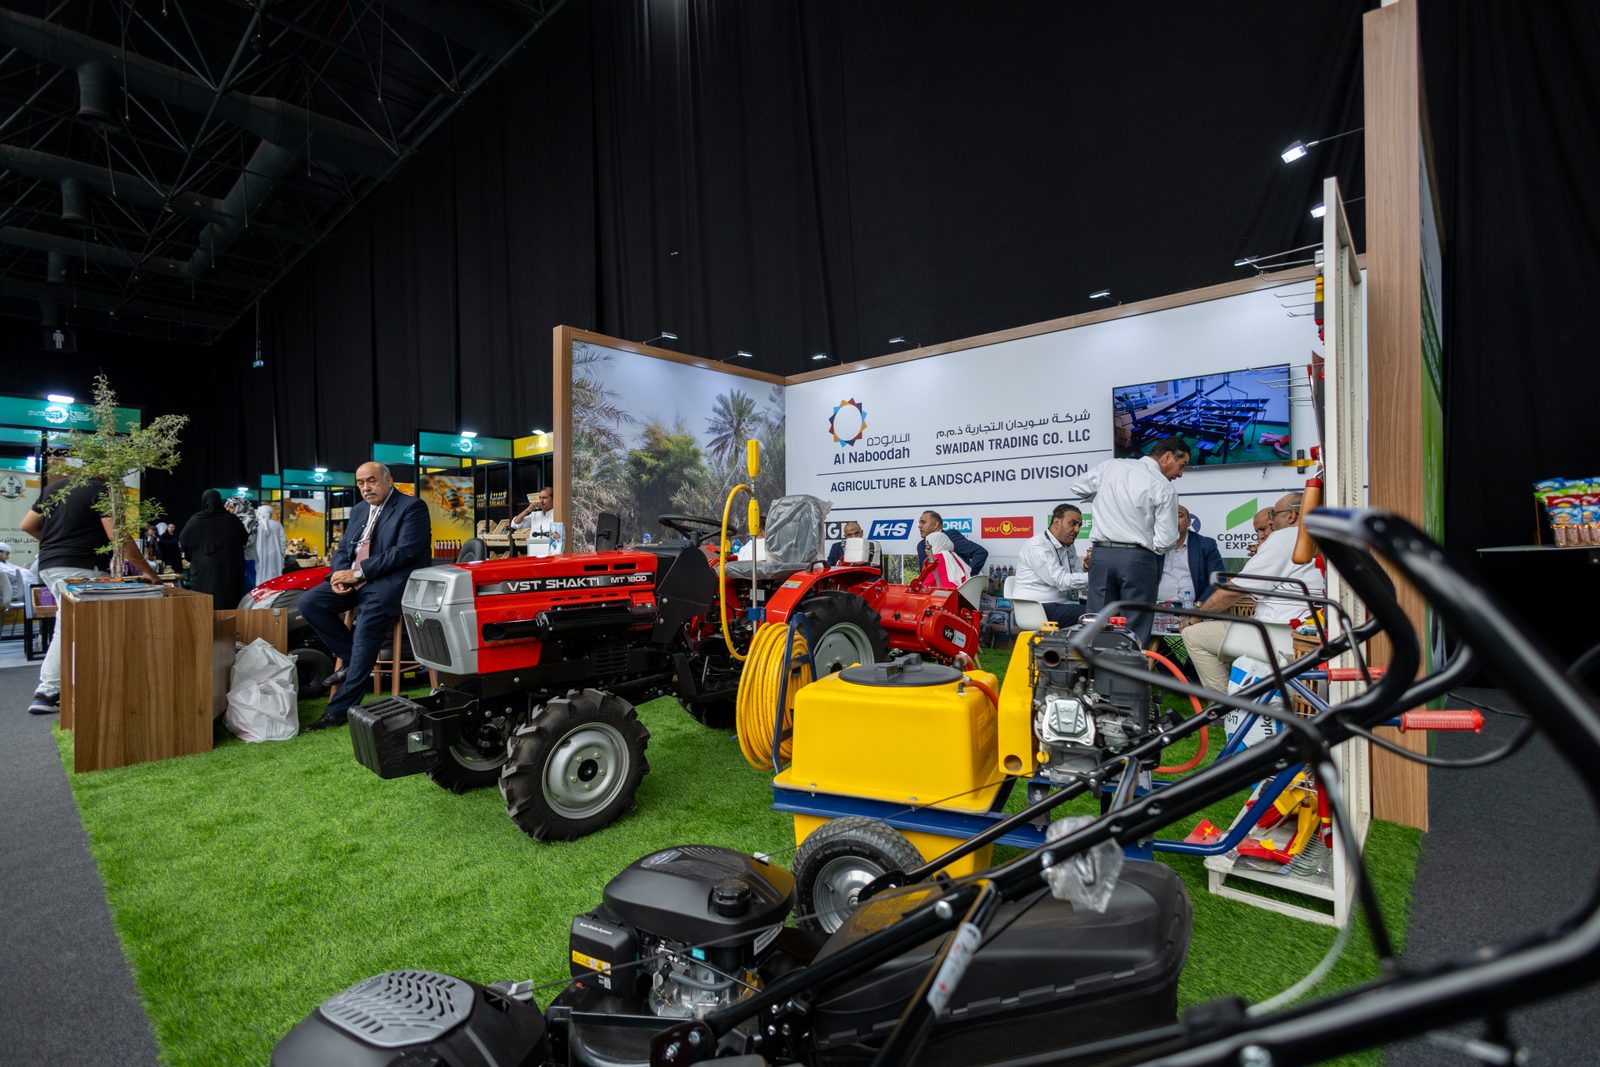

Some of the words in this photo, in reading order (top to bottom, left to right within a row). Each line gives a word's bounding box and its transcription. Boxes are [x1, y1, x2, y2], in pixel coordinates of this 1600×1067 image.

[1005, 417, 1049, 430] سويدان
[1051, 409, 1091, 423] شركة
[965, 421, 1004, 436] التجارية
[935, 440, 985, 455] SWAIDAN
[988, 434, 1038, 450] TRADING
[1043, 432, 1063, 445] CO.
[1068, 429, 1091, 443] LLC
[833, 453, 845, 465] Al
[848, 447, 910, 463] Naboodah
[831, 477, 906, 492] AGRICULTURE
[909, 476, 918, 488] &
[921, 469, 1016, 486] LANDSCAPING
[1021, 464, 1088, 480] DIVISION
[873, 522, 907, 537] K+S
[943, 520, 971, 531] ORIA
[1217, 533, 1258, 541] COMPO
[507, 580, 541, 592] VST
[546, 576, 600, 589] SHAKTI
